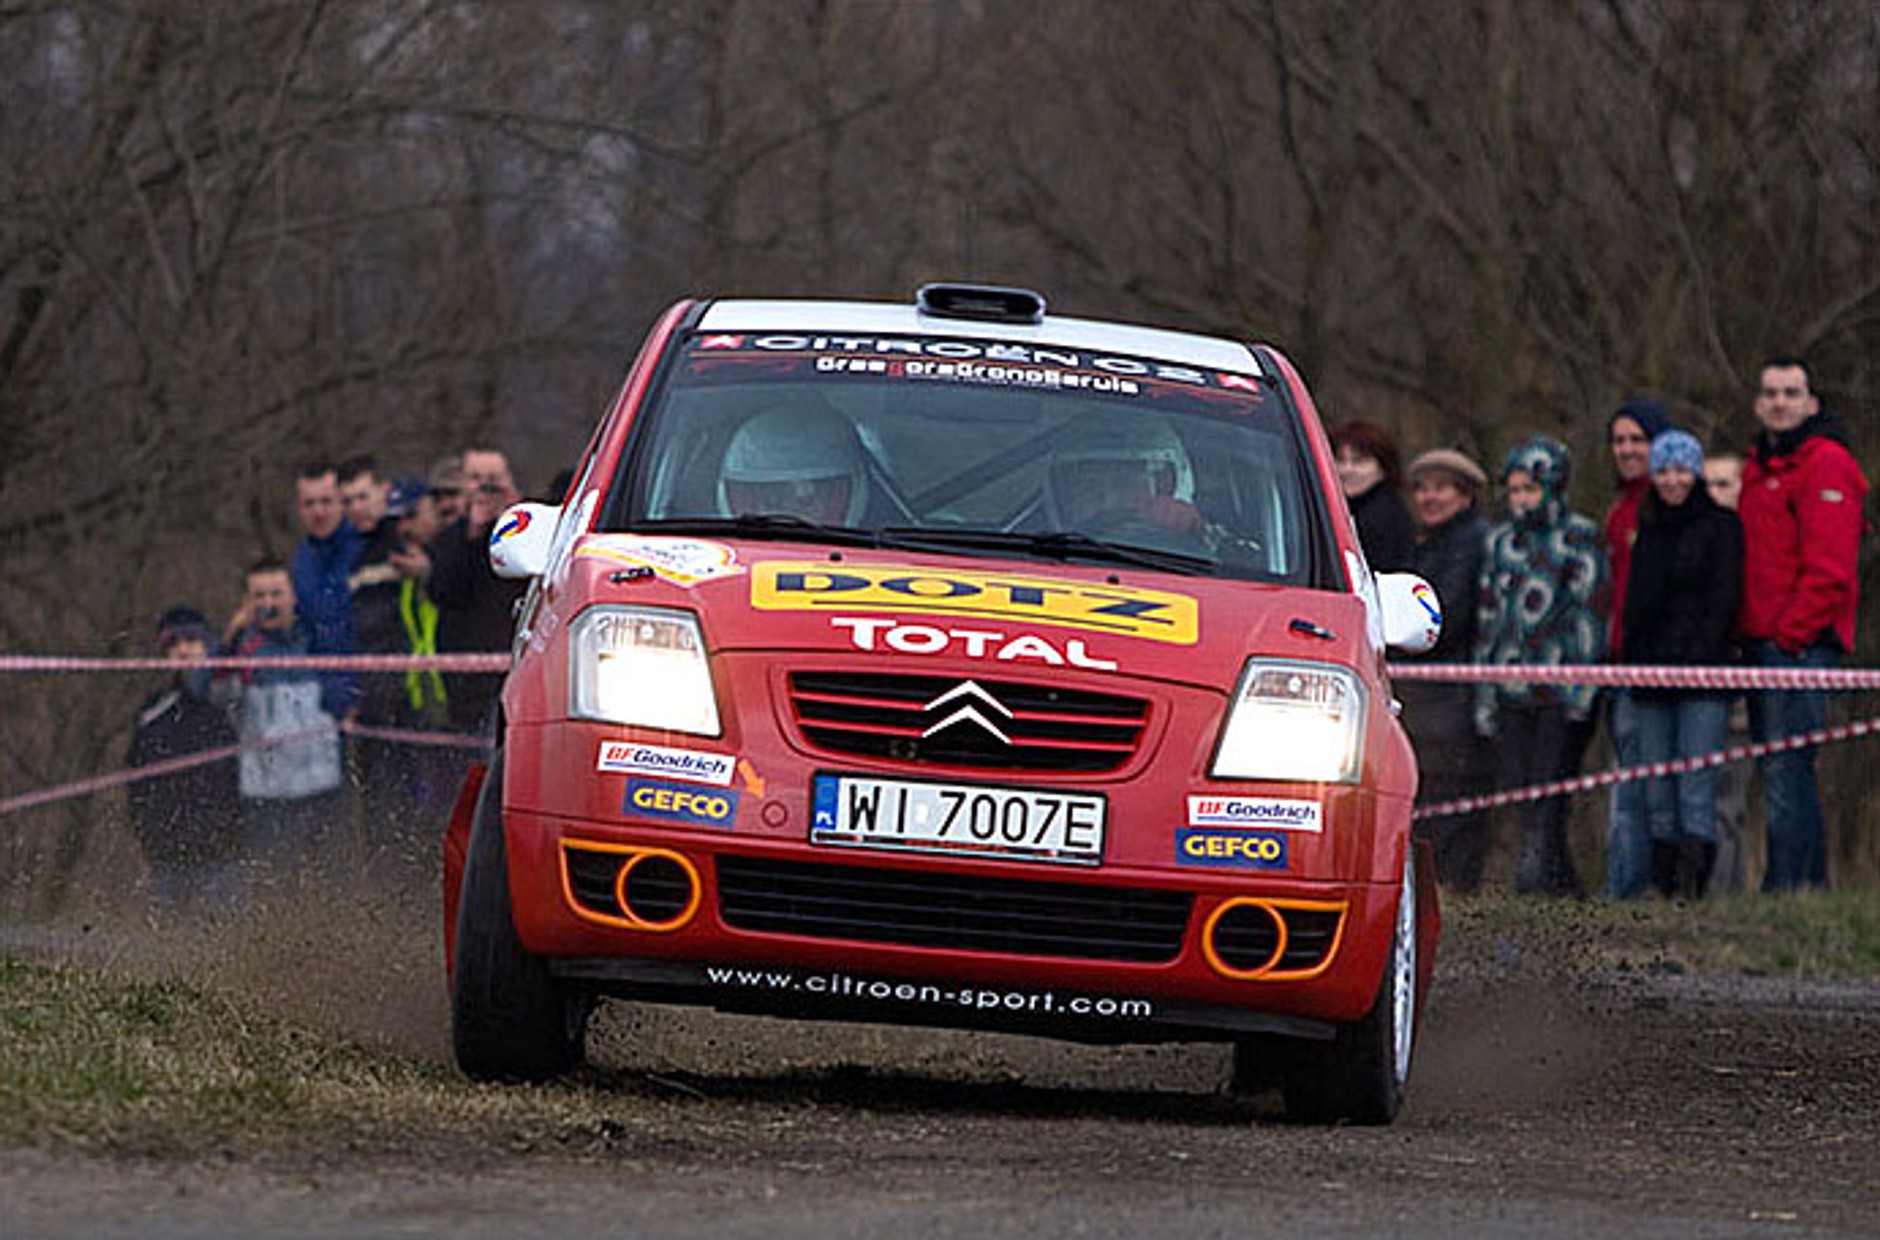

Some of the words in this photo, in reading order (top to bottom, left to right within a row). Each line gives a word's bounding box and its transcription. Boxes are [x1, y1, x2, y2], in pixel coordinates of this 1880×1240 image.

[775, 572, 1175, 626] DOTZ
[831, 616, 1118, 671] TOTAL
[606, 745, 728, 774] BFGoodrich
[633, 787, 730, 819] GEFCO
[849, 784, 908, 834] WI
[938, 791, 1098, 849] 7007E
[1197, 801, 1316, 820] BFGoodrich
[1184, 834, 1281, 861] GEFCO
[706, 966, 1153, 1018] www.citroen-sport.com
